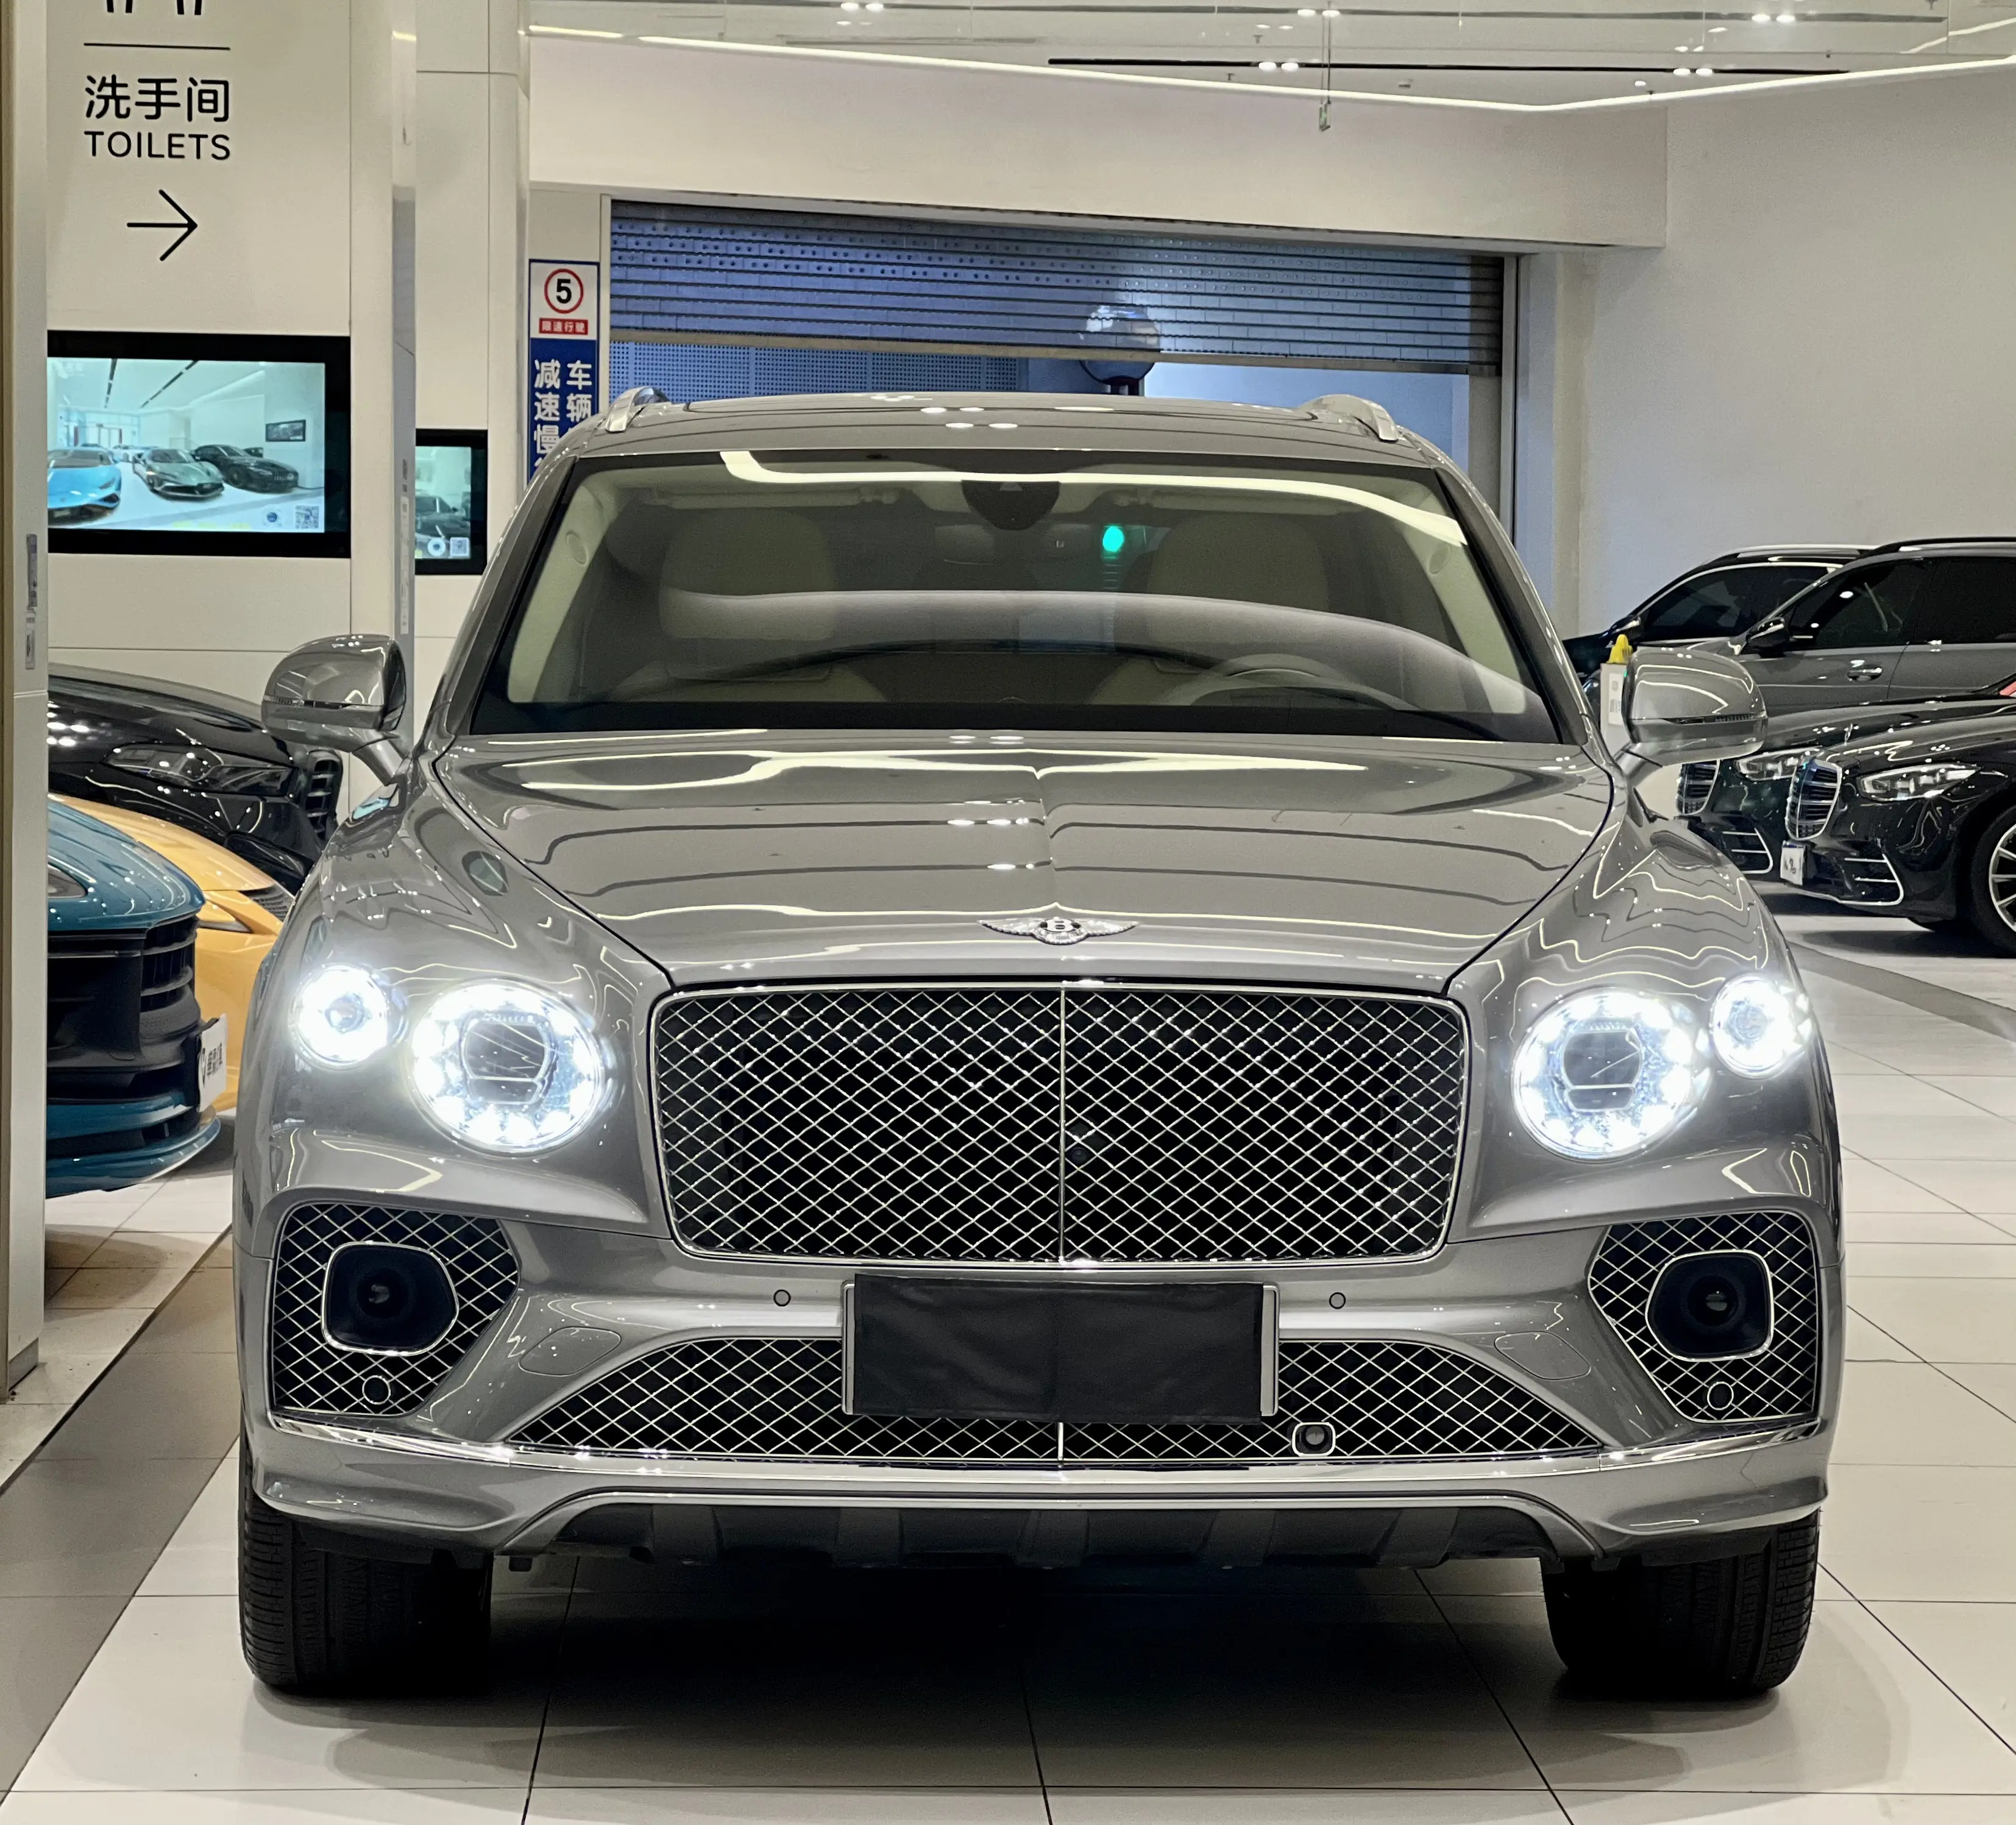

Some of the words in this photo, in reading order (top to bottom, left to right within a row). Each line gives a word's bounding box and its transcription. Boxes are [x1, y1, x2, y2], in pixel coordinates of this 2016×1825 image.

[85, 74, 230, 123] 洗手间
[84, 130, 230, 160] TOILETS
[556, 278, 572, 304] 5
[534, 359, 560, 468] 减速慢
[566, 360, 592, 430] 车辆
